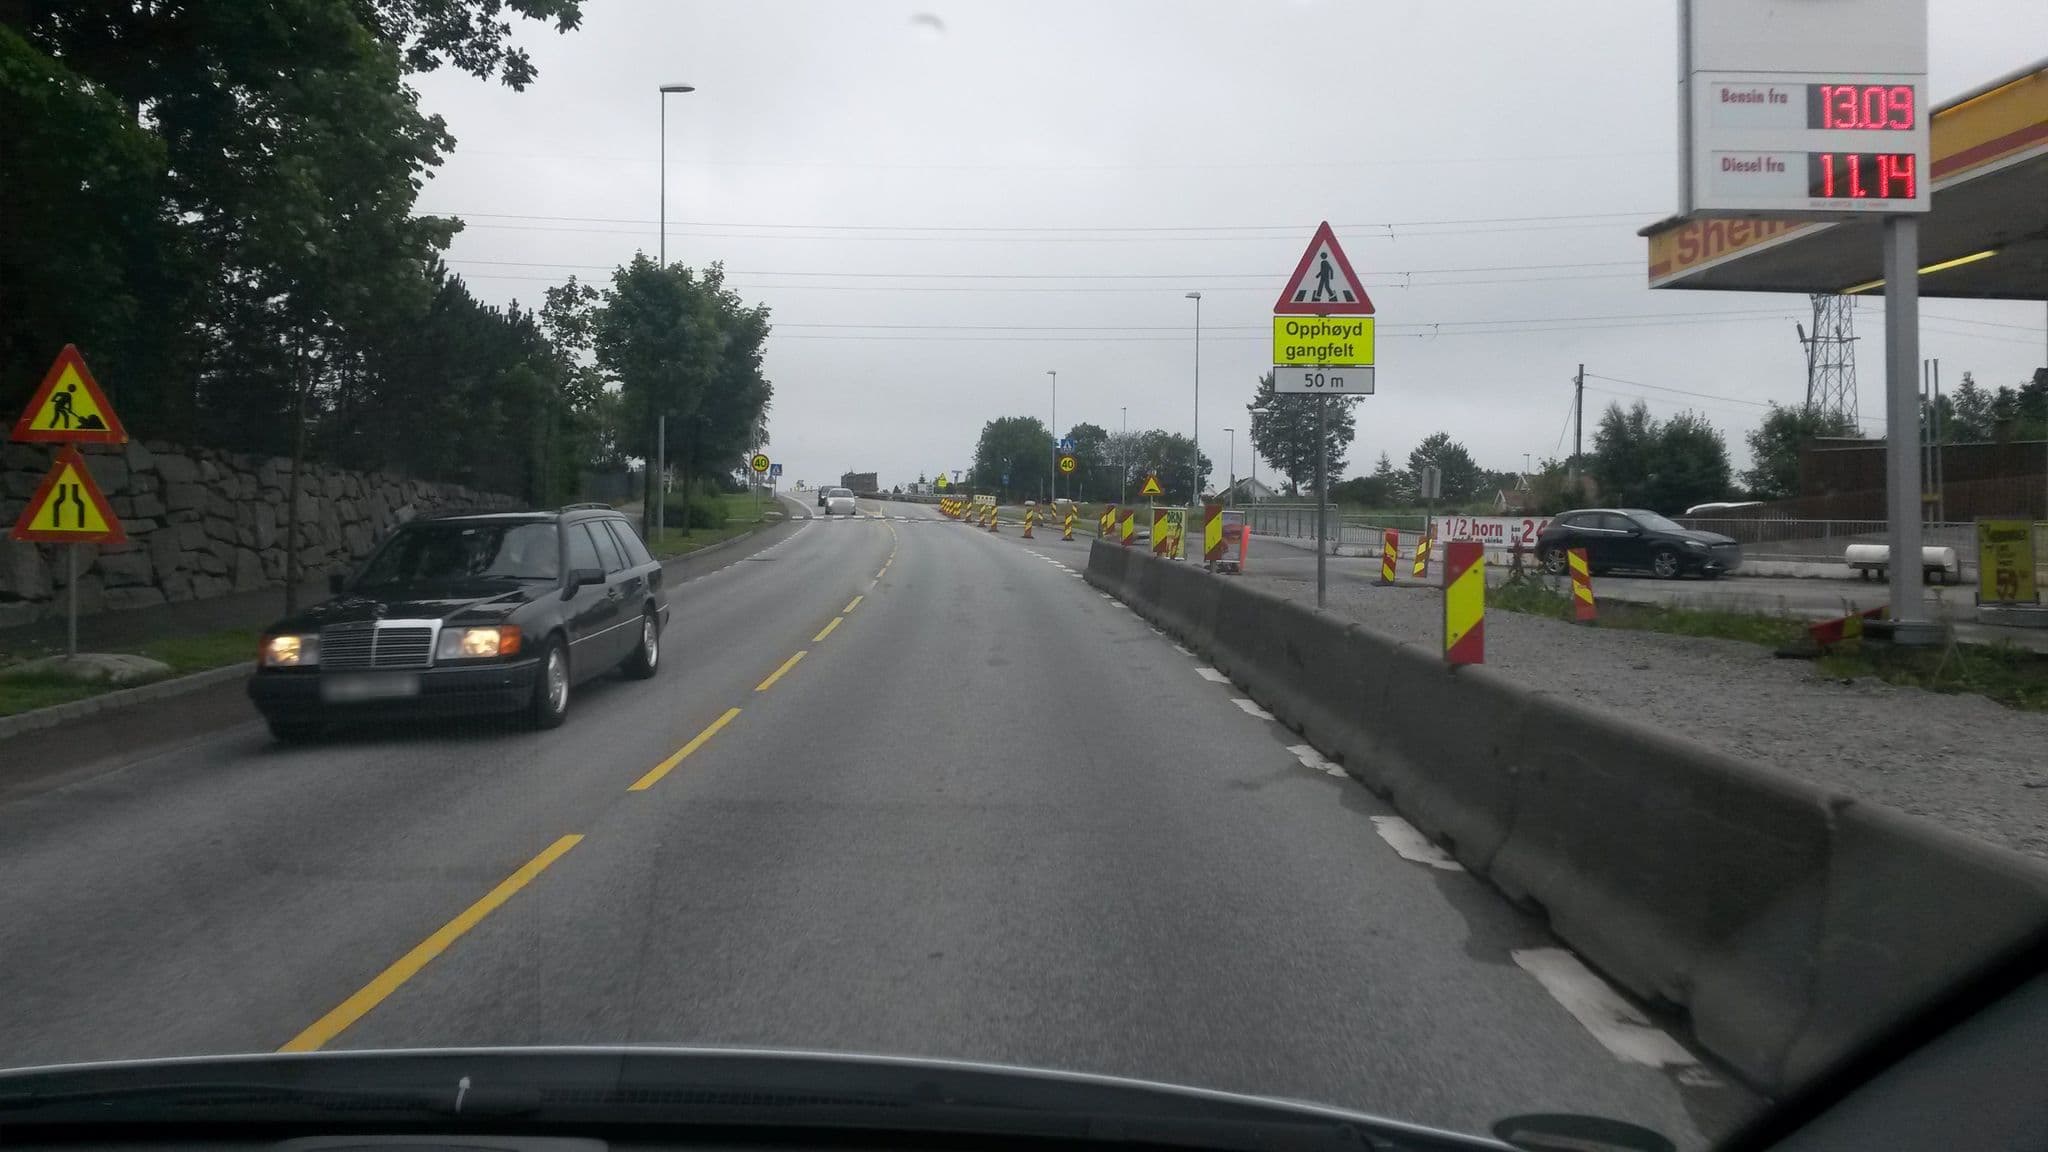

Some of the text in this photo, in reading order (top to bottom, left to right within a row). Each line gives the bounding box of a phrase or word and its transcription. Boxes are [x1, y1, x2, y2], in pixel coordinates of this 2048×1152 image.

[1721, 88, 1788, 104] Bensin fra
[1821, 84, 1915, 130] 13.09
[1721, 156, 1785, 172] Diesel fra
[1821, 154, 1916, 198] 11.14
[1677, 219, 1777, 265] She
[1286, 321, 1362, 340] Opphøyd
[1286, 343, 1354, 360] gangfelt
[1305, 373, 1344, 388] 50 m
[755, 459, 766, 467] 40
[1062, 459, 1074, 469] 40
[1446, 518, 1503, 537] 1/2 horn
